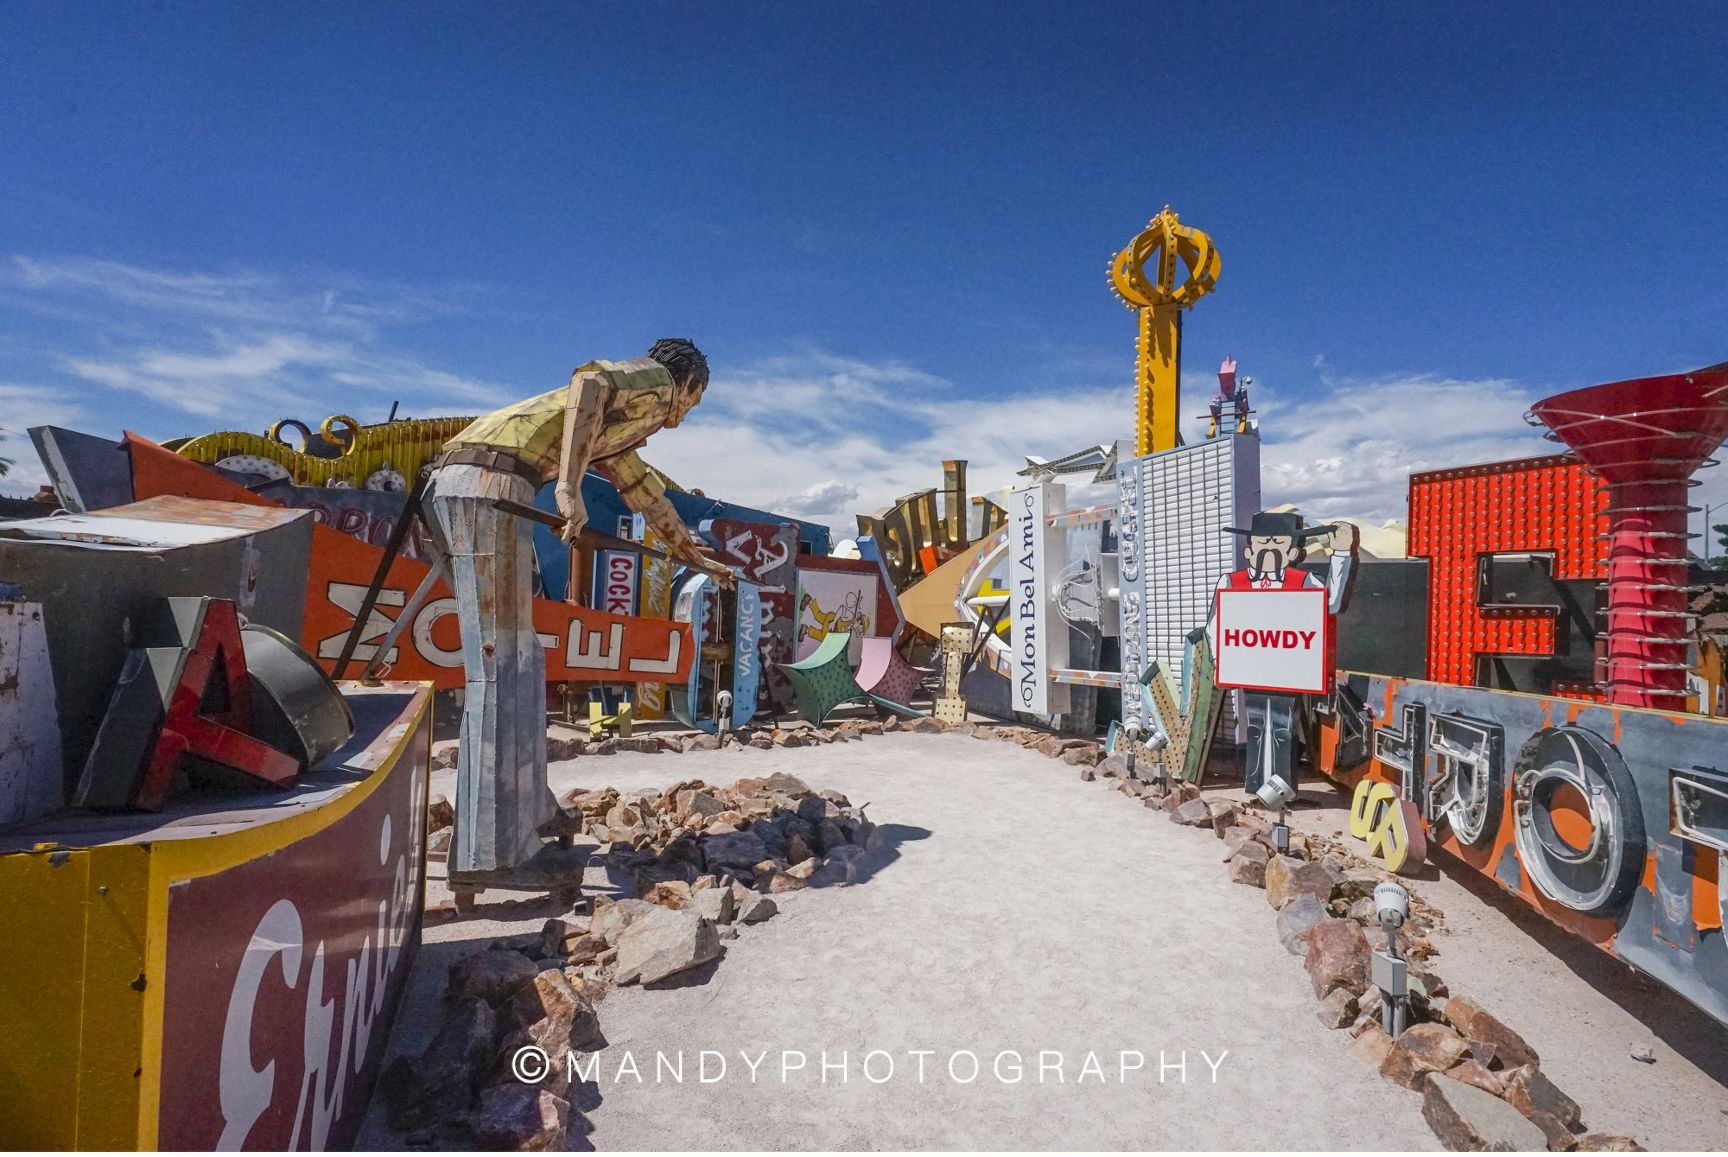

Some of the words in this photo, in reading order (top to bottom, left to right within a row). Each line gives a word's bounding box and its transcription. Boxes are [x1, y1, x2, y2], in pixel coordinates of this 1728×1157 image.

[1018, 493, 1035, 571] Ami
[737, 592, 755, 678] VACANCY
[1020, 576, 1035, 621] Bel
[1018, 624, 1037, 708] Mon
[1224, 628, 1316, 650] HOWDY
